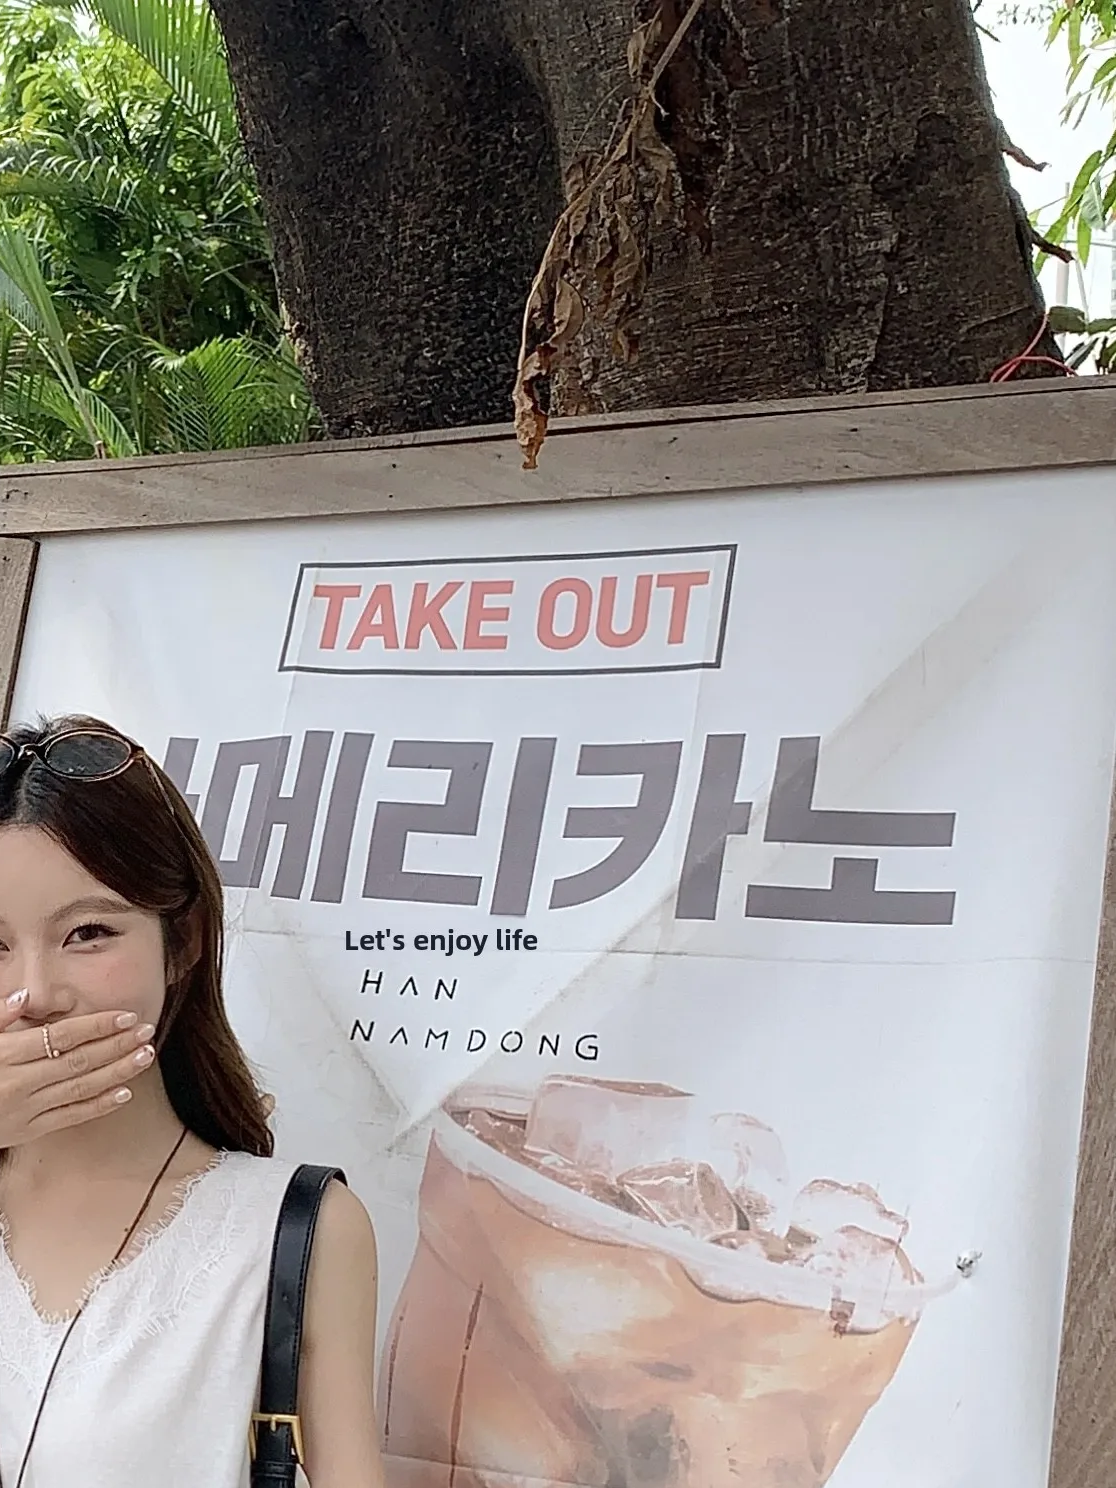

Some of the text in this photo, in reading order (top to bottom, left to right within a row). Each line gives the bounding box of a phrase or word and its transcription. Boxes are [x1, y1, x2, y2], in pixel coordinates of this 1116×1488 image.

[313, 570, 711, 651] TAKE OUT
[164, 729, 957, 926] 메리카노
[345, 928, 538, 956] Let's enjoy life
[360, 968, 458, 1000] HAN
[349, 1018, 599, 1061] NAMDONG
